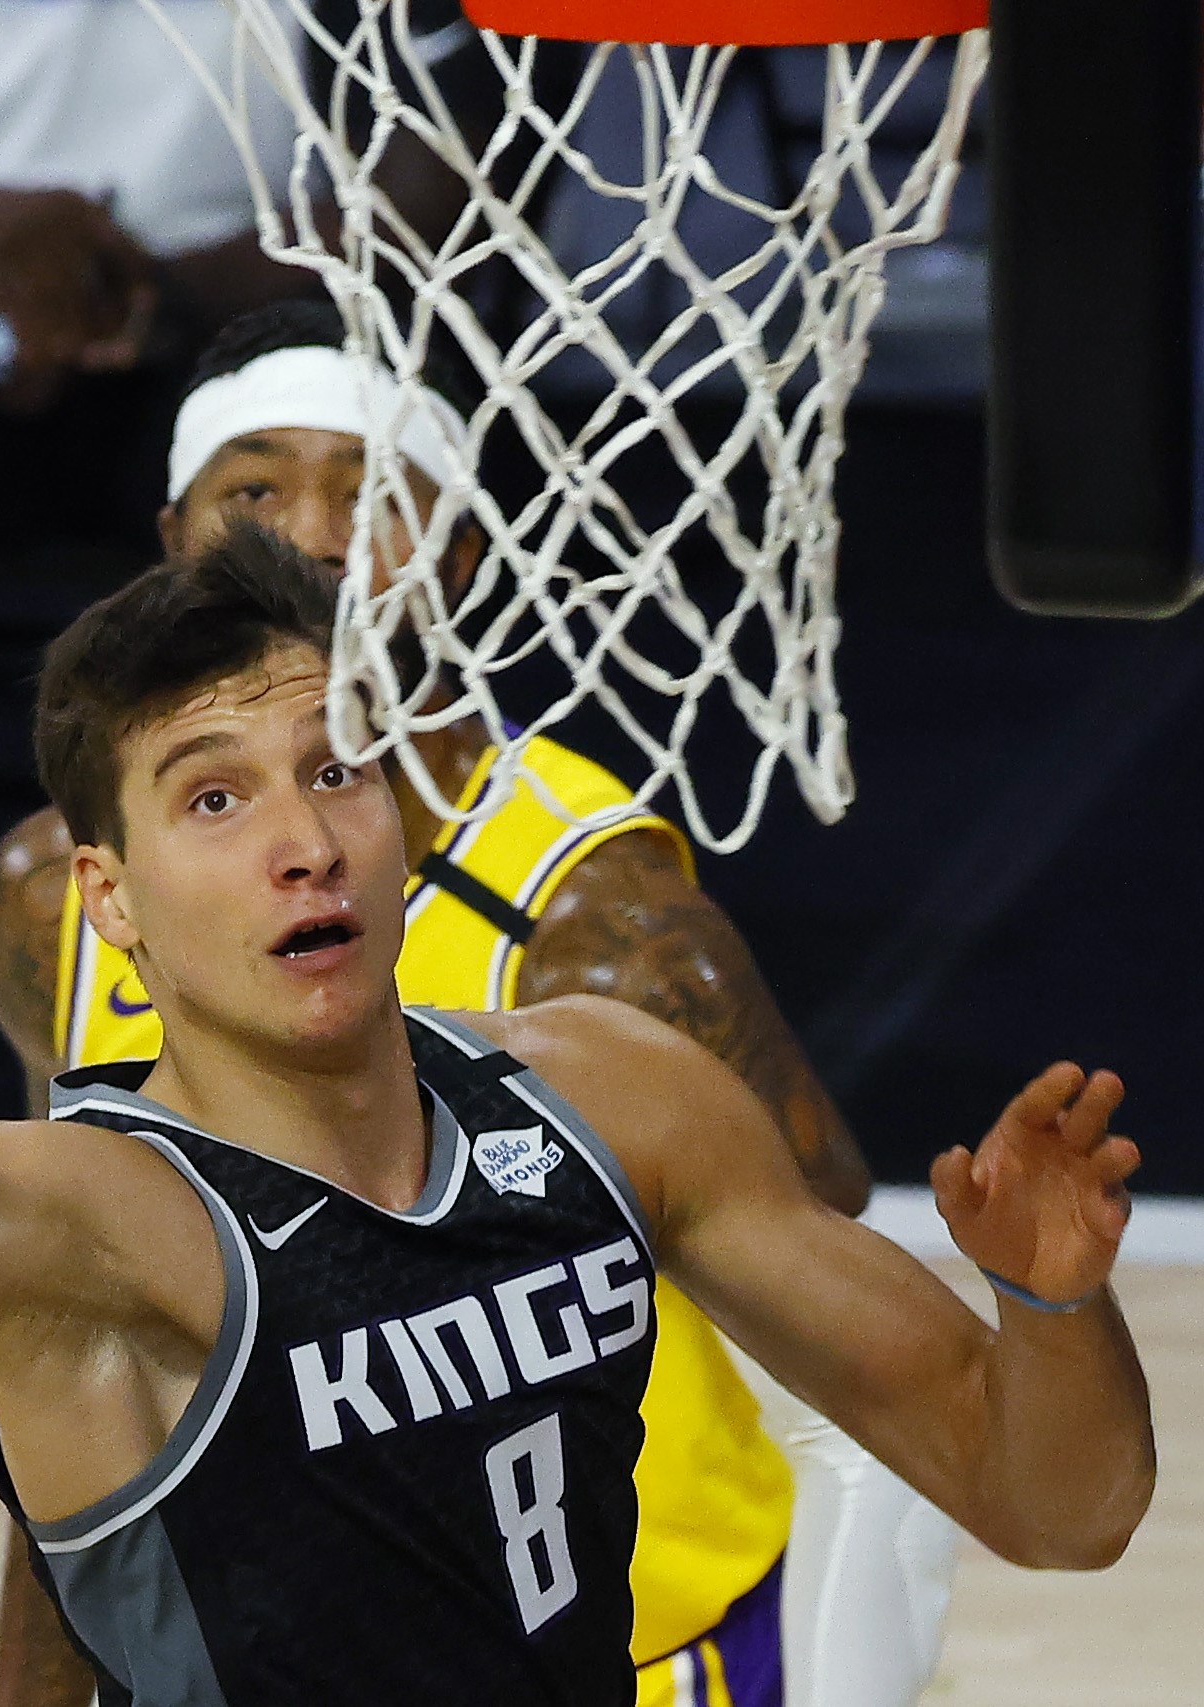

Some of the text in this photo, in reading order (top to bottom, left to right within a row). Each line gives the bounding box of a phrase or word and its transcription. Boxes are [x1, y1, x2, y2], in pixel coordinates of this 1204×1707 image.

[481, 1139, 513, 1162] BLUE
[288, 1236, 650, 1452] KINGS
[484, 1412, 579, 1636] 8
